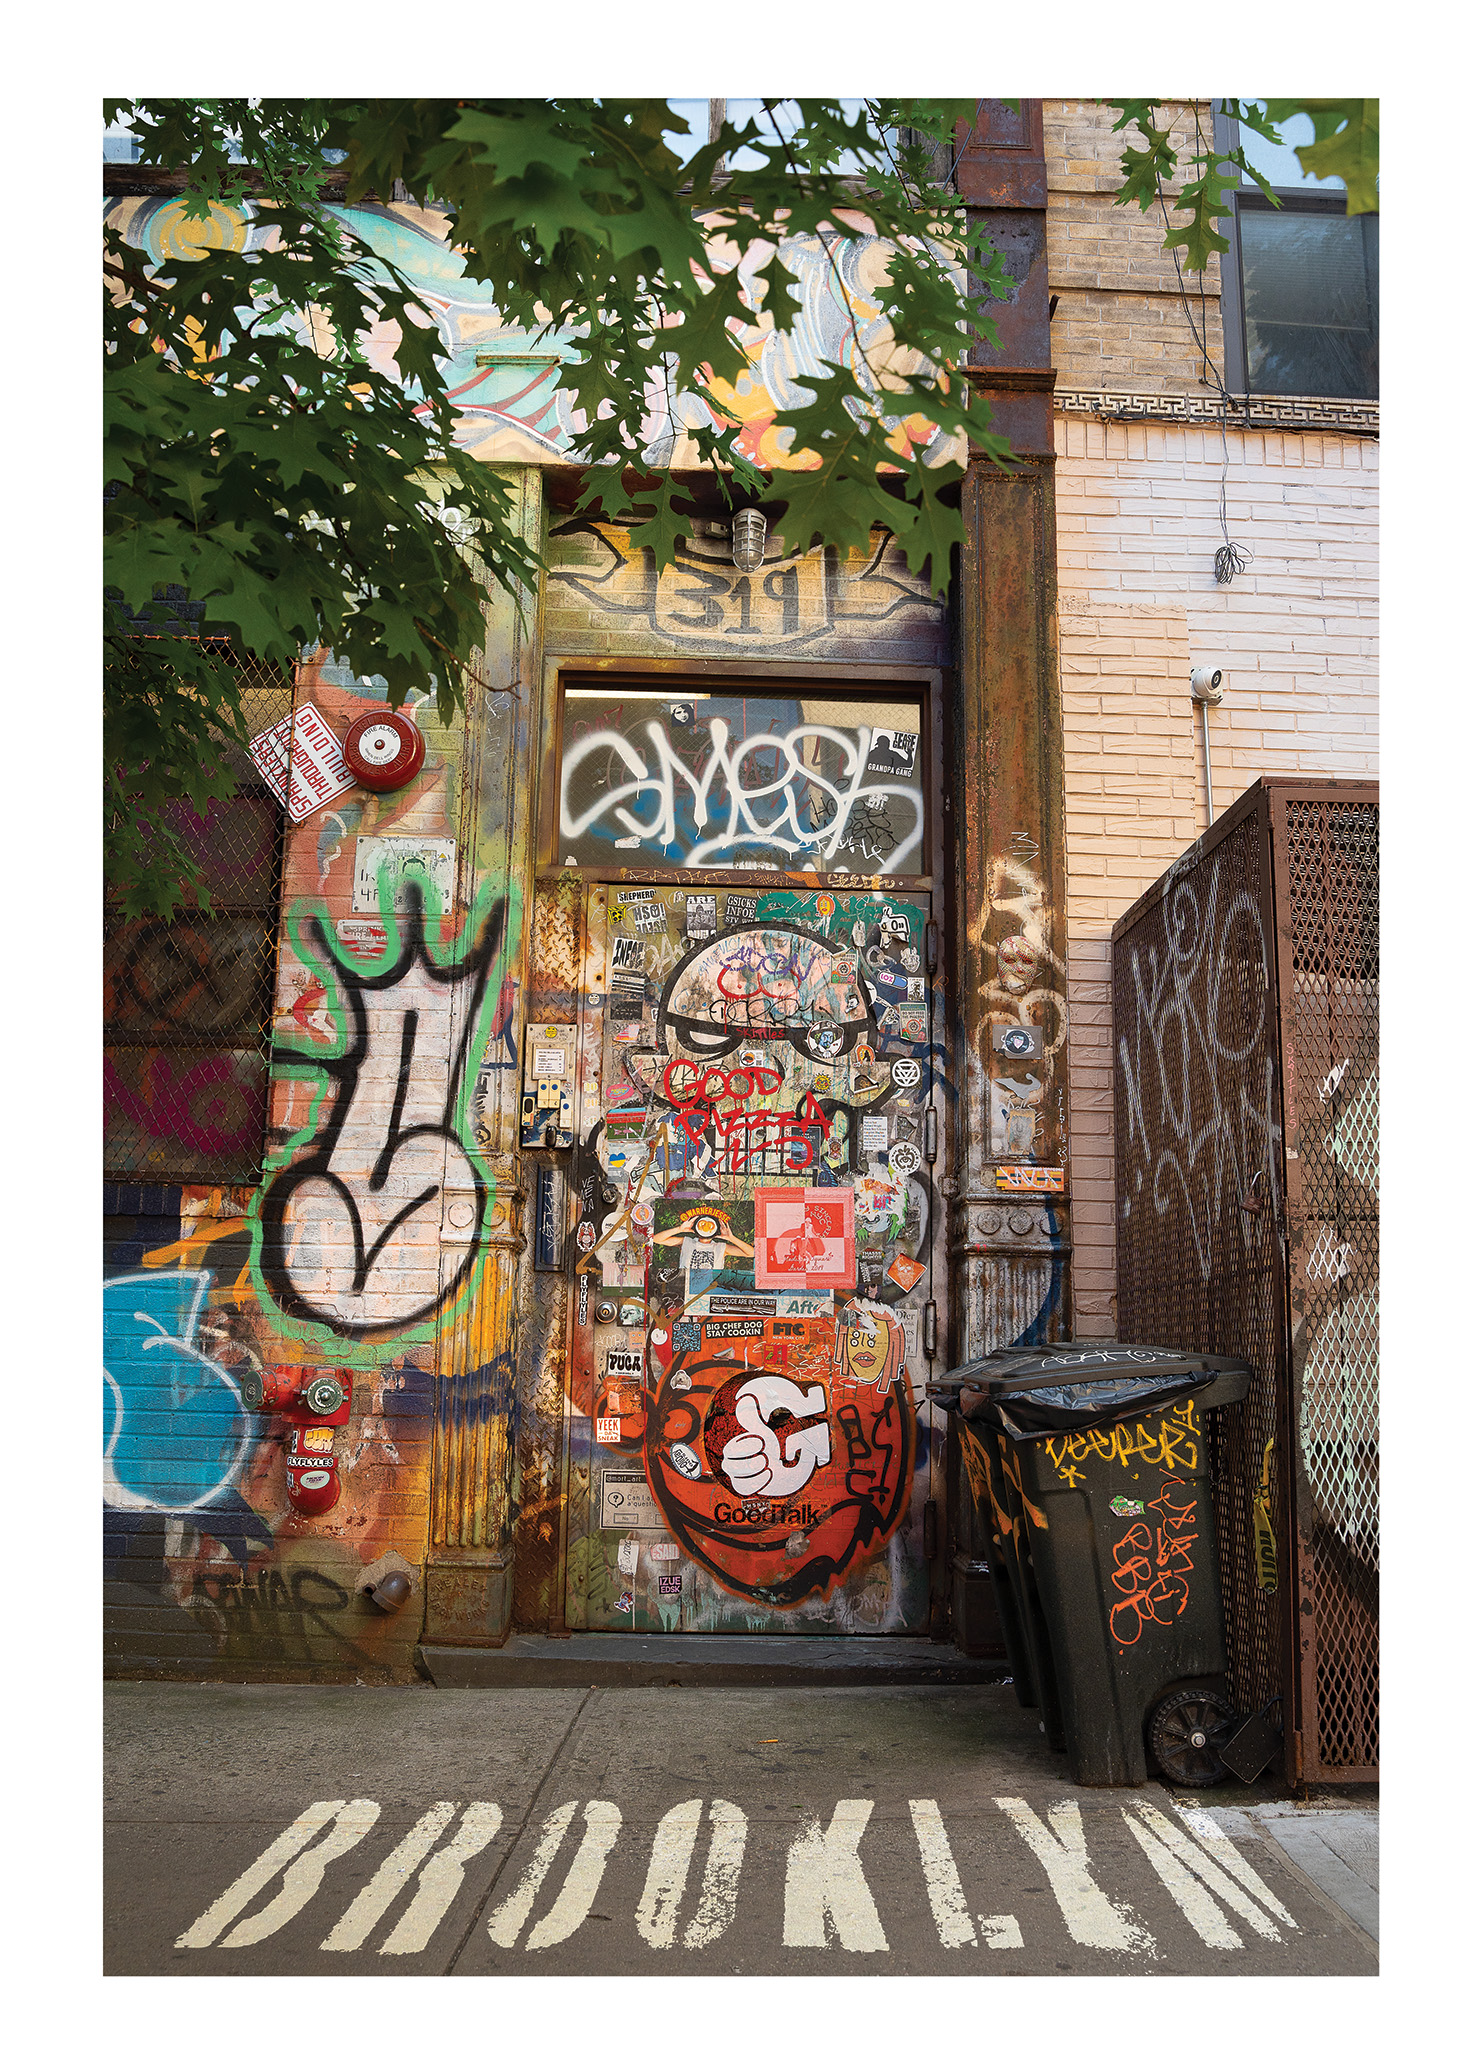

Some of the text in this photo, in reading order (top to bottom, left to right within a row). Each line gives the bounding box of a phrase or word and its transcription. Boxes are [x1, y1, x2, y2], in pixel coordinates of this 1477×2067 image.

[667, 564, 799, 634] 319
[363, 725, 398, 739] FIRE ALARM
[296, 713, 351, 783] BUILDING
[867, 762, 912, 778] GRANDPA GANG
[687, 896, 716, 904] ARE
[664, 1058, 783, 1108] GOOD
[680, 1206, 732, 1224] @WARNERJESSE
[720, 1297, 738, 1305] POLICE
[706, 1321, 763, 1331] BIG CHEF DOG
[772, 1322, 805, 1335] FTC
[706, 1328, 761, 1338] STAY COOKIN
[609, 1353, 642, 1372] PUCA
[598, 1419, 619, 1431] YEEK
[659, 1576, 681, 1586] IZUE
[660, 1586, 680, 1594] EDSK
[174, 1798, 1301, 1961] BROOKLYN
